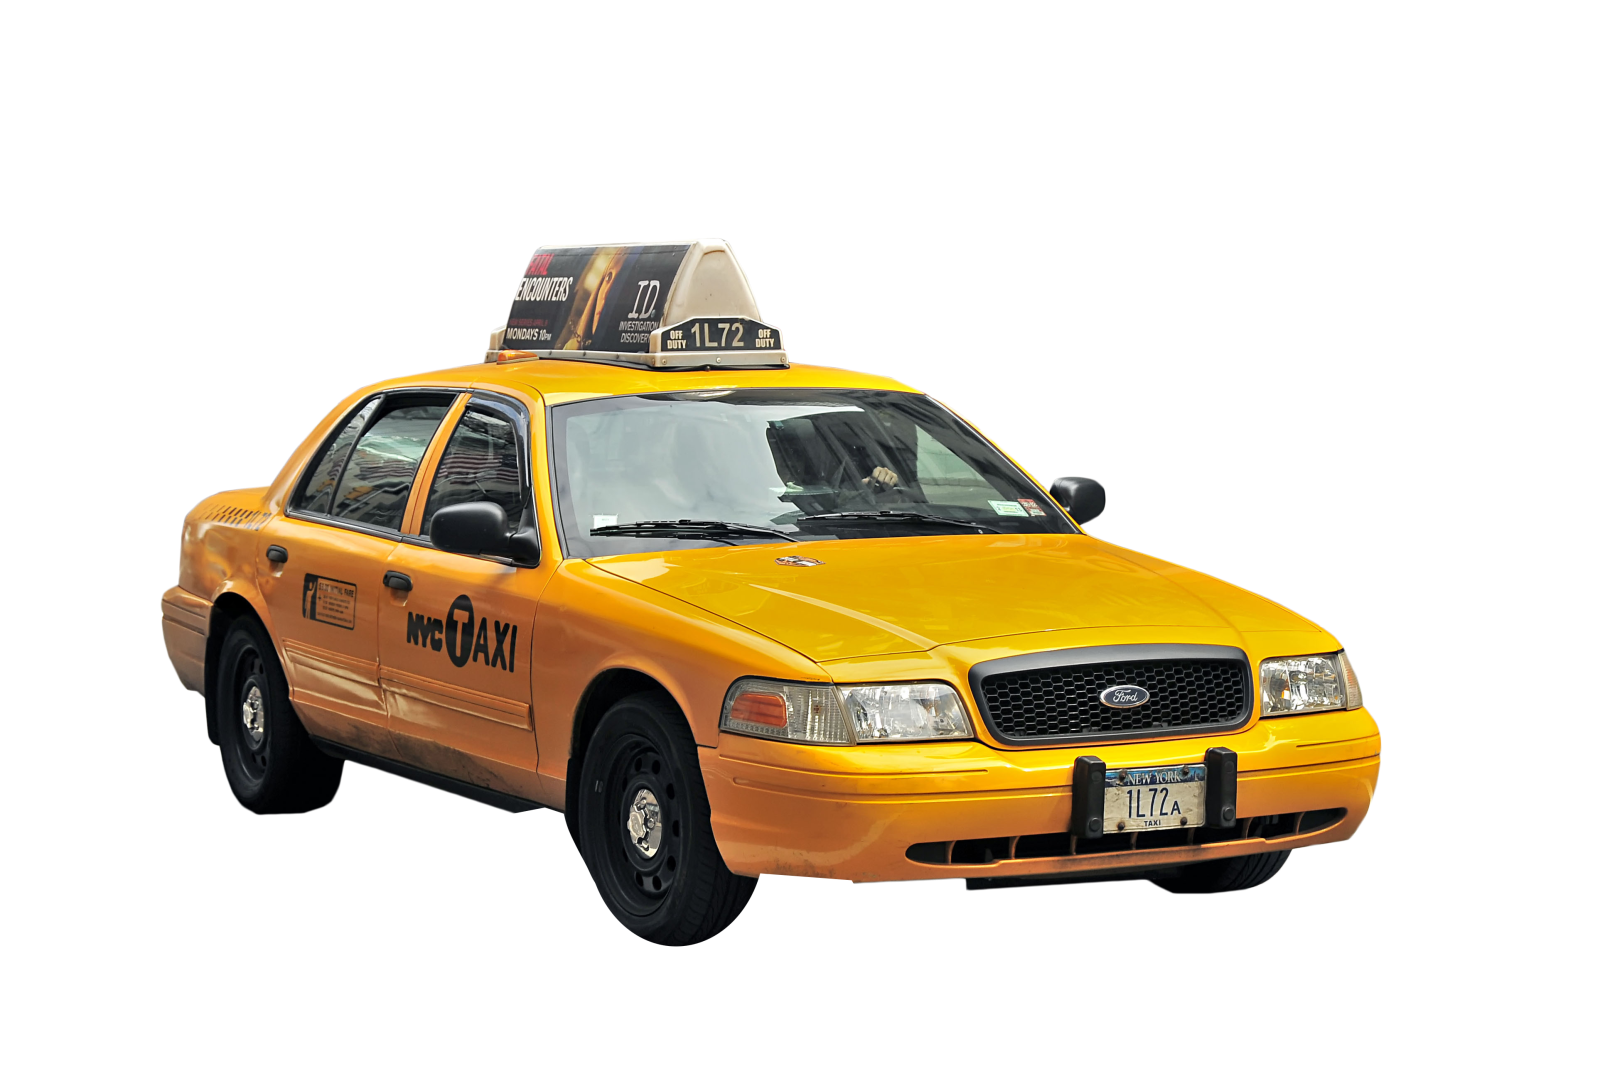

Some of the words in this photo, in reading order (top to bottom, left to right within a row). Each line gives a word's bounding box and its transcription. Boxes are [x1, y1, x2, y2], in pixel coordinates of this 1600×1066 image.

[515, 277, 573, 302] ENCOUNTERS
[618, 321, 660, 332] INVESTIGATION
[506, 328, 539, 341] MONDAYS
[670, 330, 683, 340] OFF
[691, 322, 745, 347] 1L72
[758, 329, 771, 339] OFF
[667, 339, 687, 349] DUTY
[755, 338, 774, 348] DUTY
[407, 611, 444, 652] NYC
[1112, 689, 1138, 703] Ford
[1126, 773, 1152, 785] NEW
[1154, 771, 1182, 784] YORK
